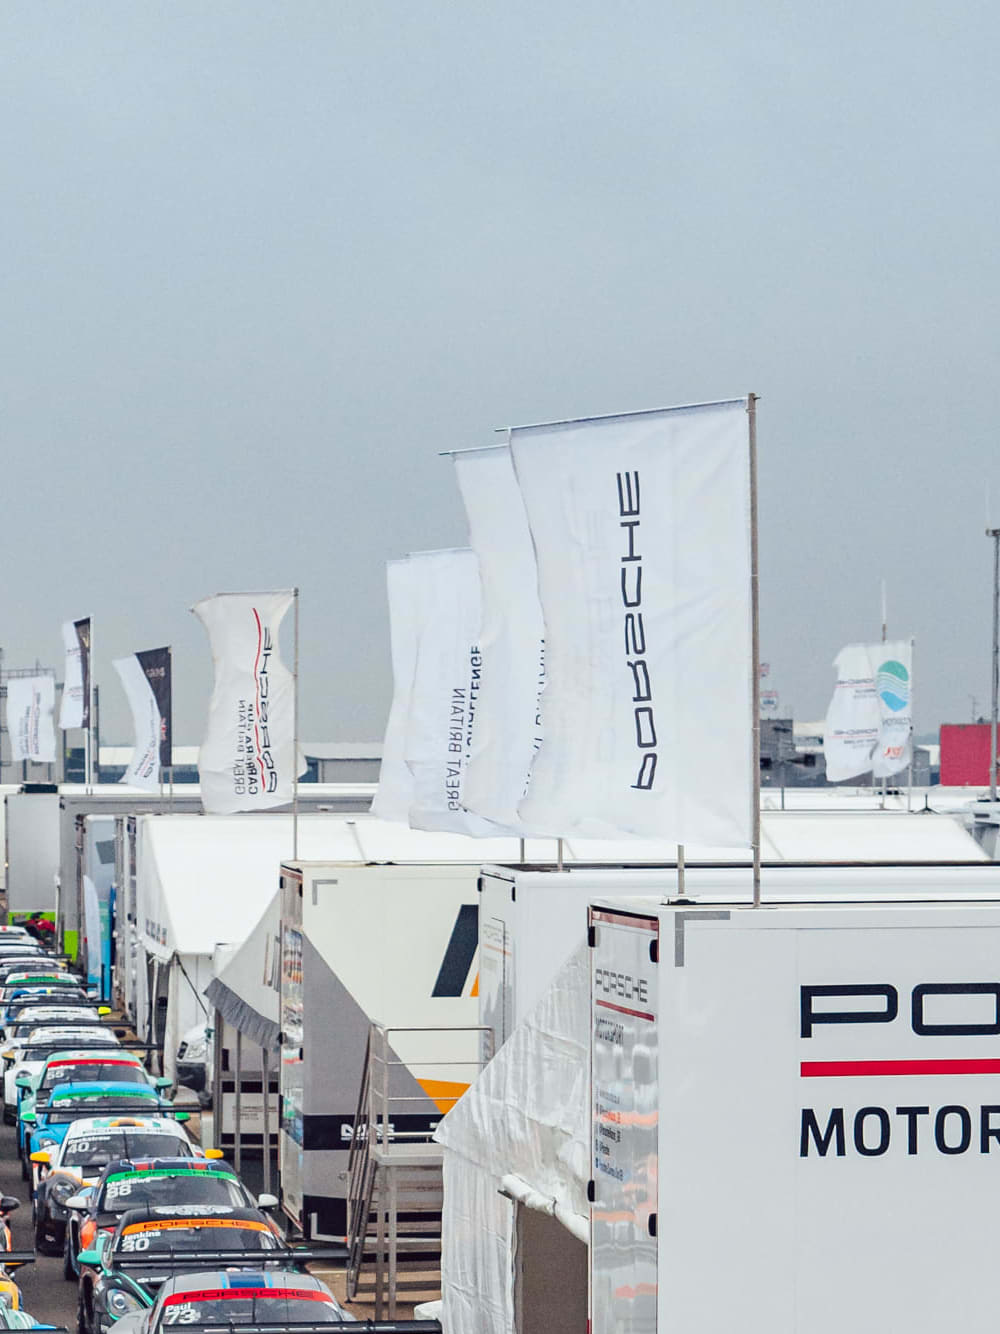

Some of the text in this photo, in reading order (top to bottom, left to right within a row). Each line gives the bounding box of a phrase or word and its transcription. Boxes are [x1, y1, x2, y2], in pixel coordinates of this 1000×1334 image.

[144, 1221, 250, 1229] PORSCHE
[183, 1290, 314, 1299] PORSCHE
[165, 1302, 192, 1313] Paul
